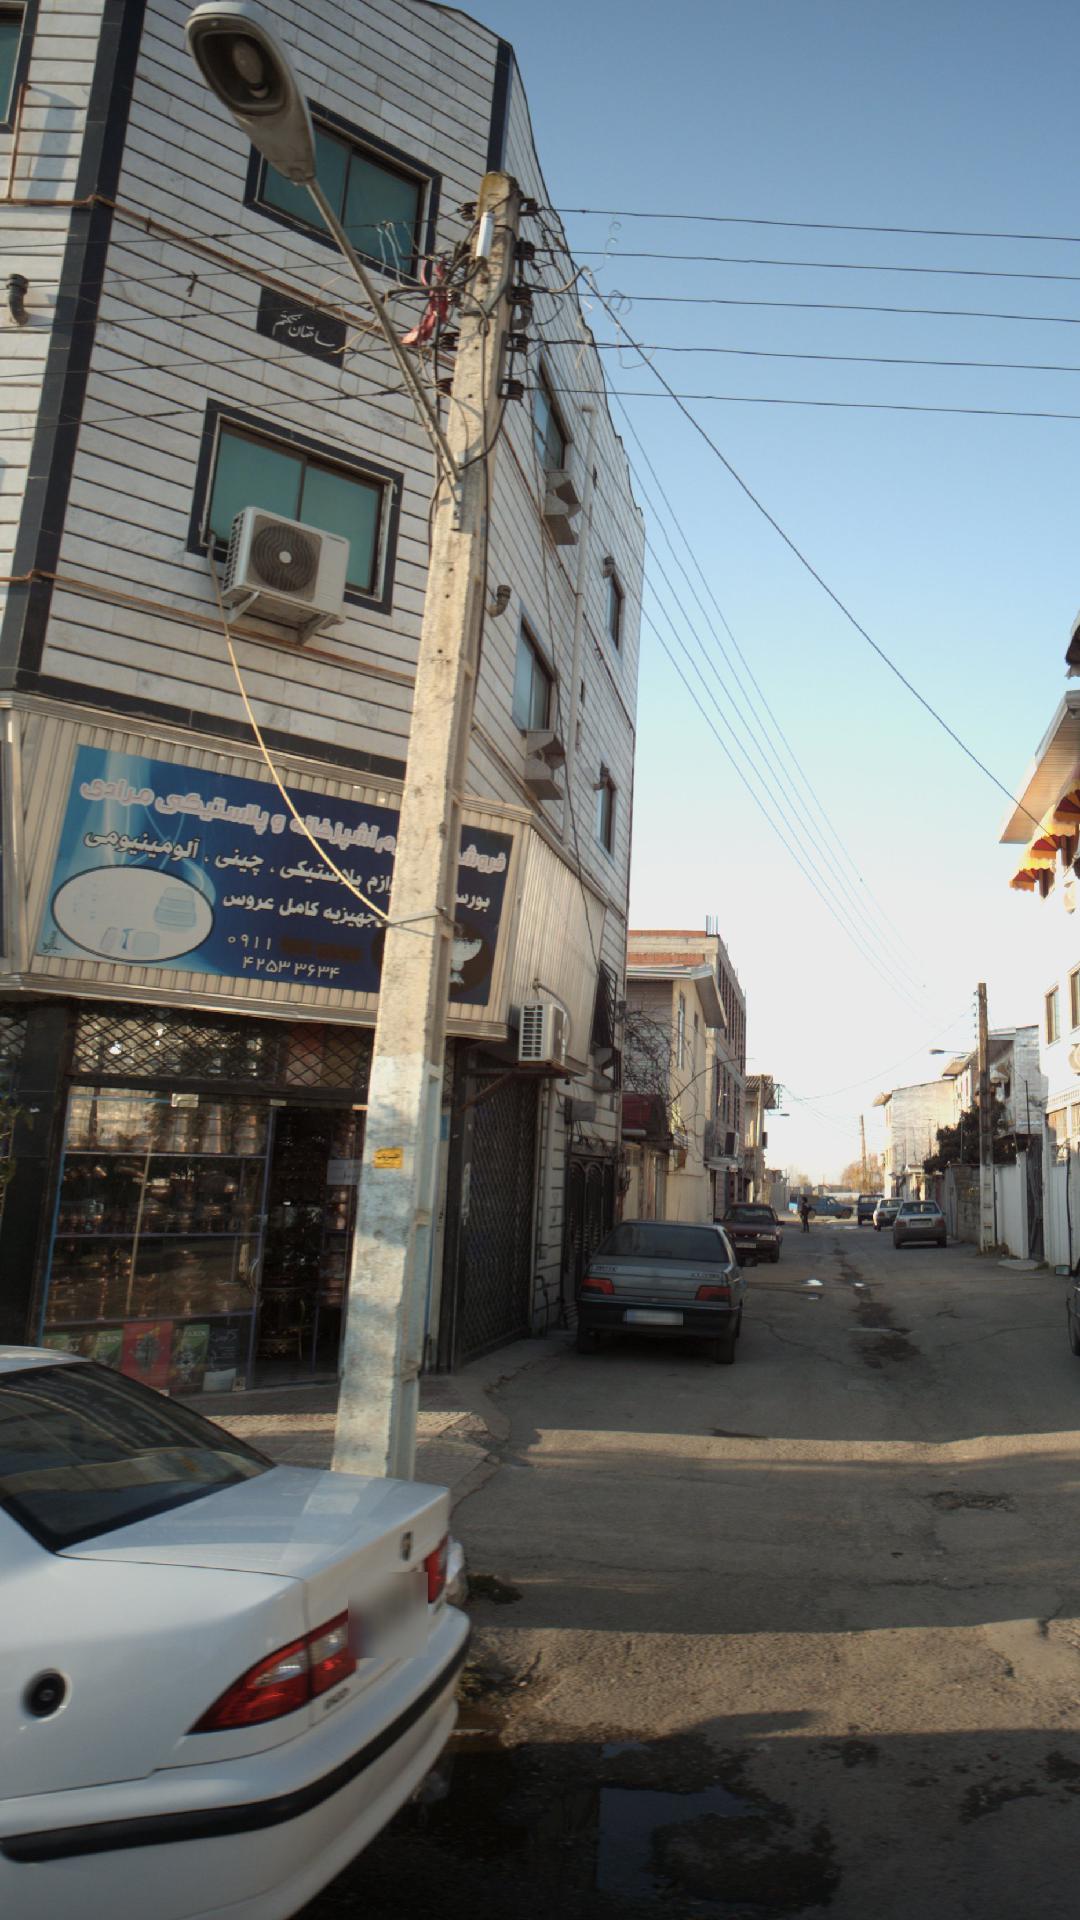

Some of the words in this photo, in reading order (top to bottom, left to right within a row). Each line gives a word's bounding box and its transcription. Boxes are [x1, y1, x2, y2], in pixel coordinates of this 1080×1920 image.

[79, 778, 155, 807] مرادی
[155, 792, 270, 836] پلاستیکی
[270, 813, 287, 835] و
[84, 830, 200, 862] آلومینیومی
[214, 849, 265, 876] چینی
[223, 893, 275, 911] عروس
[278, 898, 320, 918] کامل
